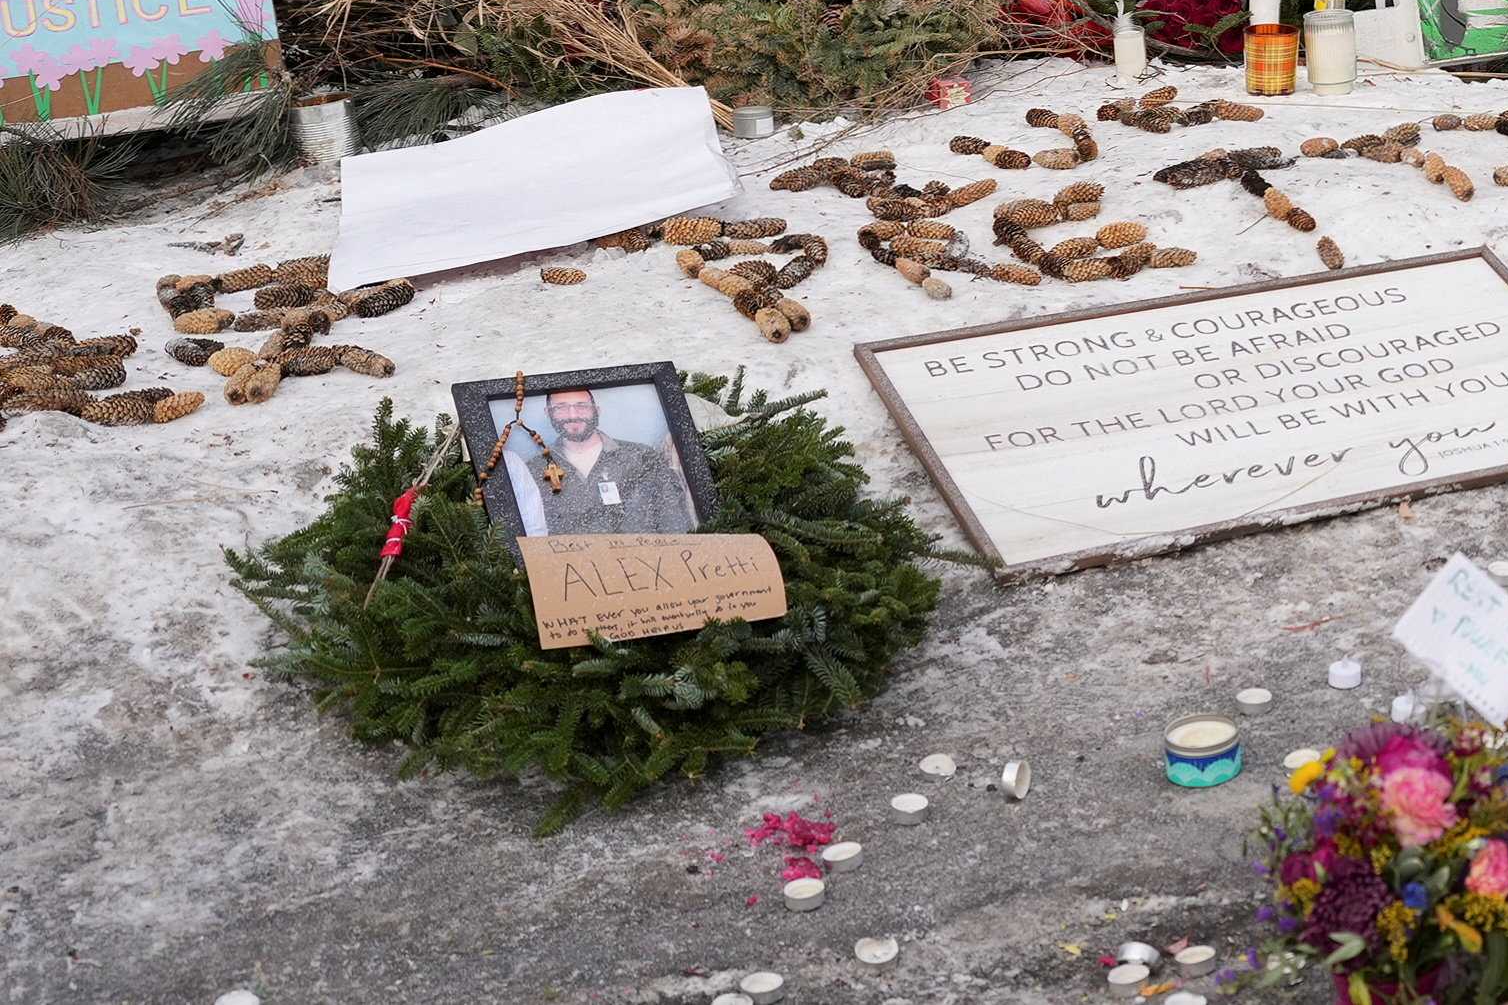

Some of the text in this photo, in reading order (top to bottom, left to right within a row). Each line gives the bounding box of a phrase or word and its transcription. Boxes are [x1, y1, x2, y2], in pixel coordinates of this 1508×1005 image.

[924, 287, 1408, 378] BE STRONG & COURAGEOUS
[1015, 323, 1352, 392] DO NOT BE AFRAID
[1194, 320, 1502, 390] OR DISCOURAGED
[983, 357, 1456, 452] FOR THE LORD YOUR GOD
[1175, 420, 1272, 448] WILL
[1277, 409, 1328, 431] BE
[1330, 388, 1432, 419] WITH
[1096, 447, 1353, 509] wherever
[1387, 420, 1497, 476] you
[542, 615, 587, 630] WHAT
[631, 607, 648, 618] you
[656, 601, 682, 611] allow
[688, 597, 709, 608] your
[716, 586, 772, 605] government
[564, 549, 759, 602] ALEX Pretti
[609, 629, 636, 640] GOD
